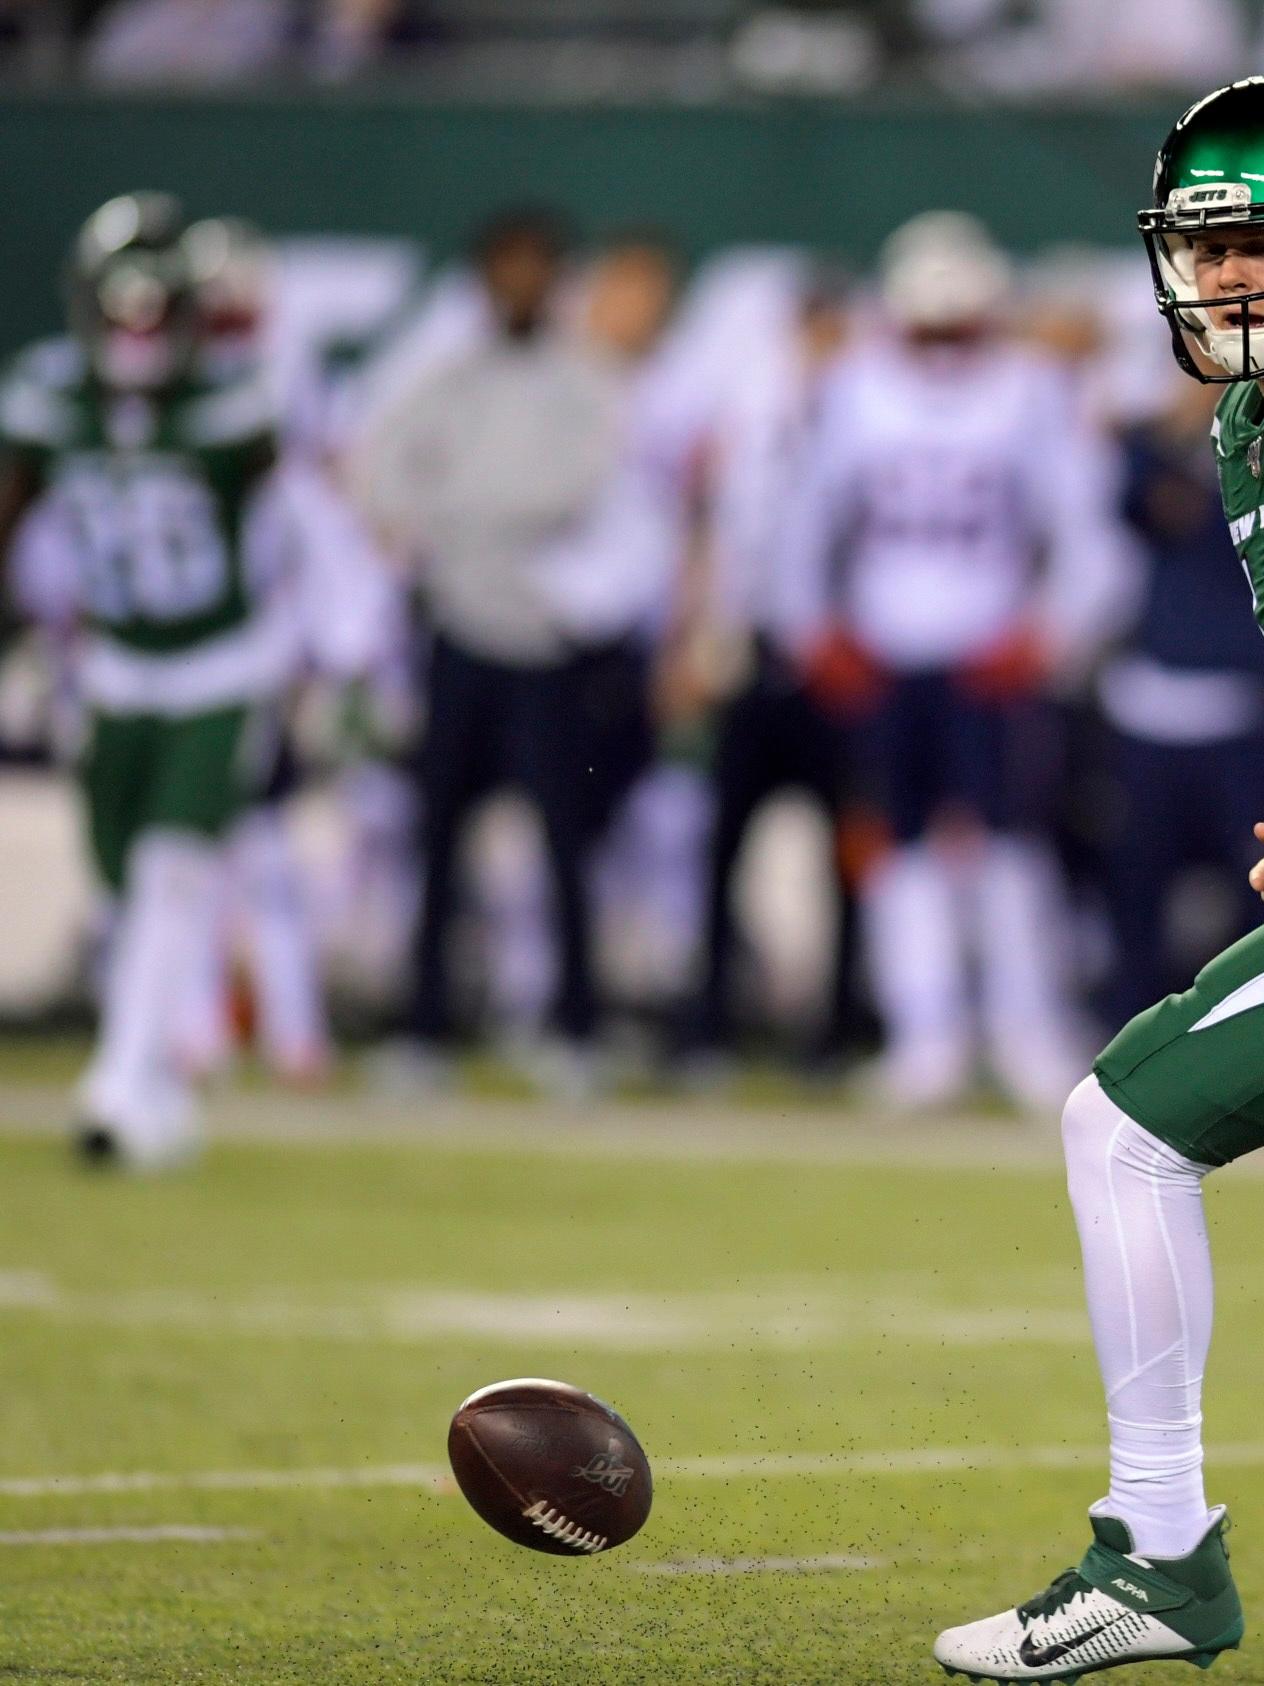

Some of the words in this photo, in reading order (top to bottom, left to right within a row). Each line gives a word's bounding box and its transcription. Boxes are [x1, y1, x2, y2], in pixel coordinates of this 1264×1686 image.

[1188, 188, 1228, 203] JETS
[1228, 510, 1256, 547] EW
[1110, 1577, 1149, 1603] ALPHA
